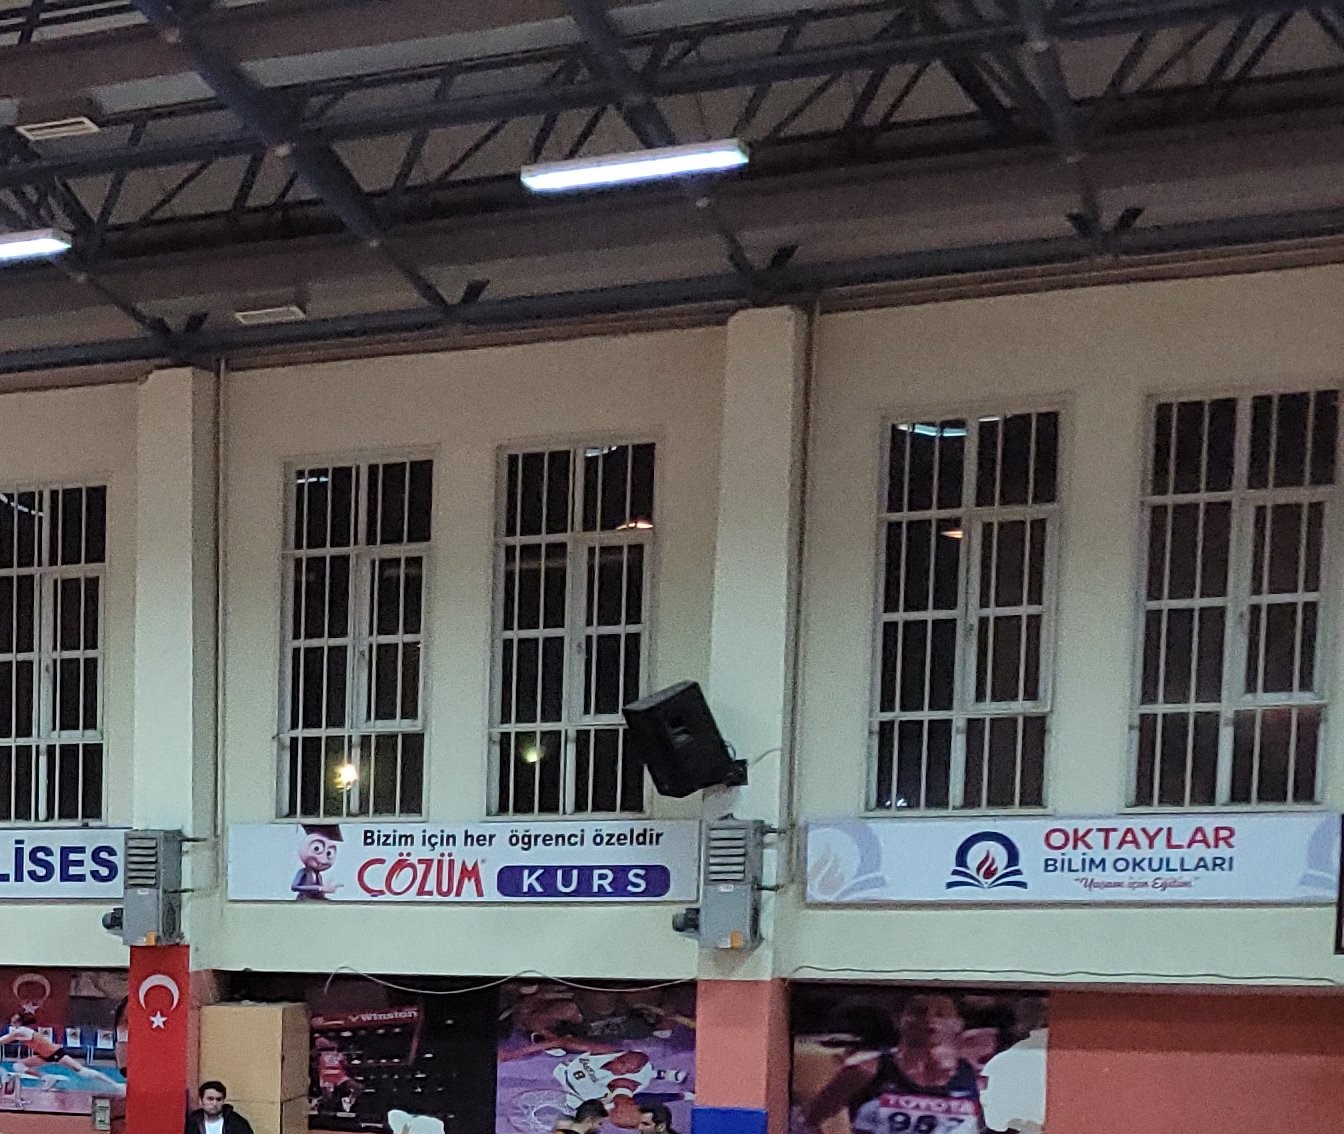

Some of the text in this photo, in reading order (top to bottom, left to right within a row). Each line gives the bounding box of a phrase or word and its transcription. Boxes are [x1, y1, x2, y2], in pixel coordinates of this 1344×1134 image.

[363, 827, 664, 851] Bizim için her öğrenci özeldir
[1044, 826, 1236, 850] OKTAYLAR
[357, 852, 485, 898] ÇÖZÜM
[1043, 852, 1234, 874] BİLİM OKULLARI
[522, 868, 648, 894] KURS
